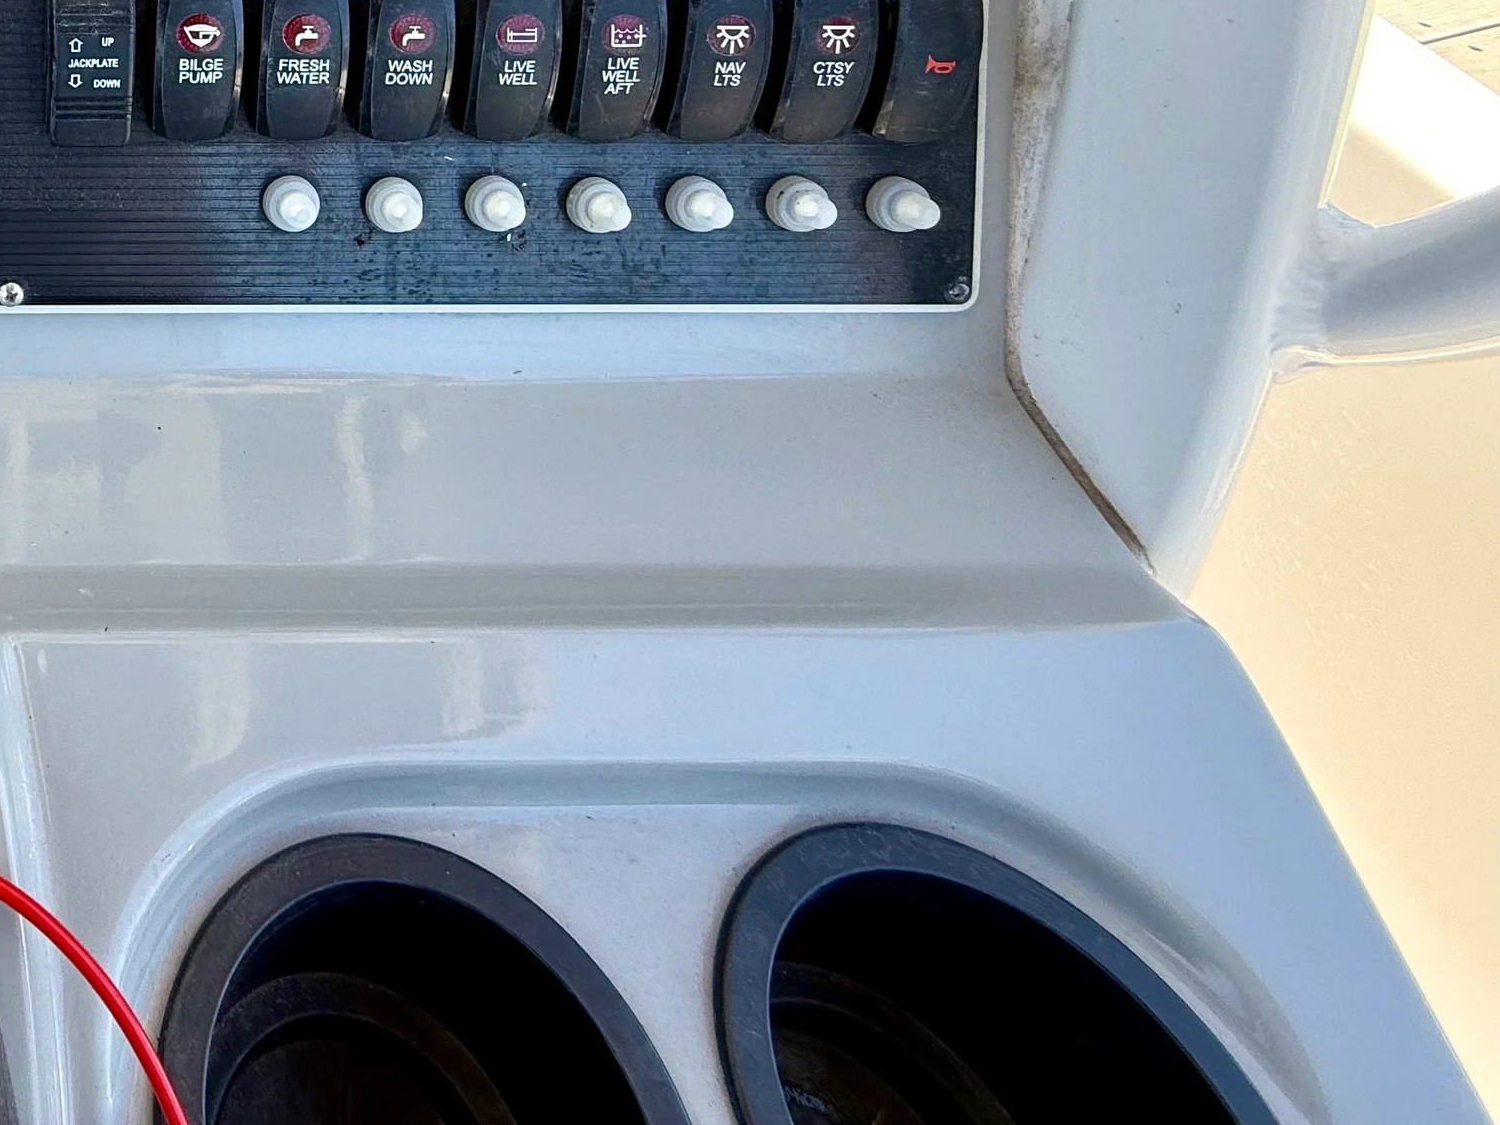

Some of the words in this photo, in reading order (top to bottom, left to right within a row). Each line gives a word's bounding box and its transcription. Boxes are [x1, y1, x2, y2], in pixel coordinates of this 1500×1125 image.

[102, 38, 114, 47] UP
[68, 59, 119, 68] JACKPLATE
[179, 59, 223, 71] BILGE
[279, 59, 330, 71] FRESH
[388, 60, 433, 72] WASH
[504, 61, 536, 73] LIVE
[608, 58, 639, 70] LIVE
[715, 62, 746, 73] NAV
[813, 62, 854, 73] CTSY
[179, 72, 223, 84] PUMP
[276, 73, 330, 84] WATER
[385, 73, 433, 85] DOWN
[499, 74, 537, 85] WELL
[602, 71, 640, 82] WELL
[713, 75, 741, 87] LTS
[817, 75, 844, 87] LTS
[94, 79, 120, 88] DOWN
[604, 83, 634, 95] AFT
